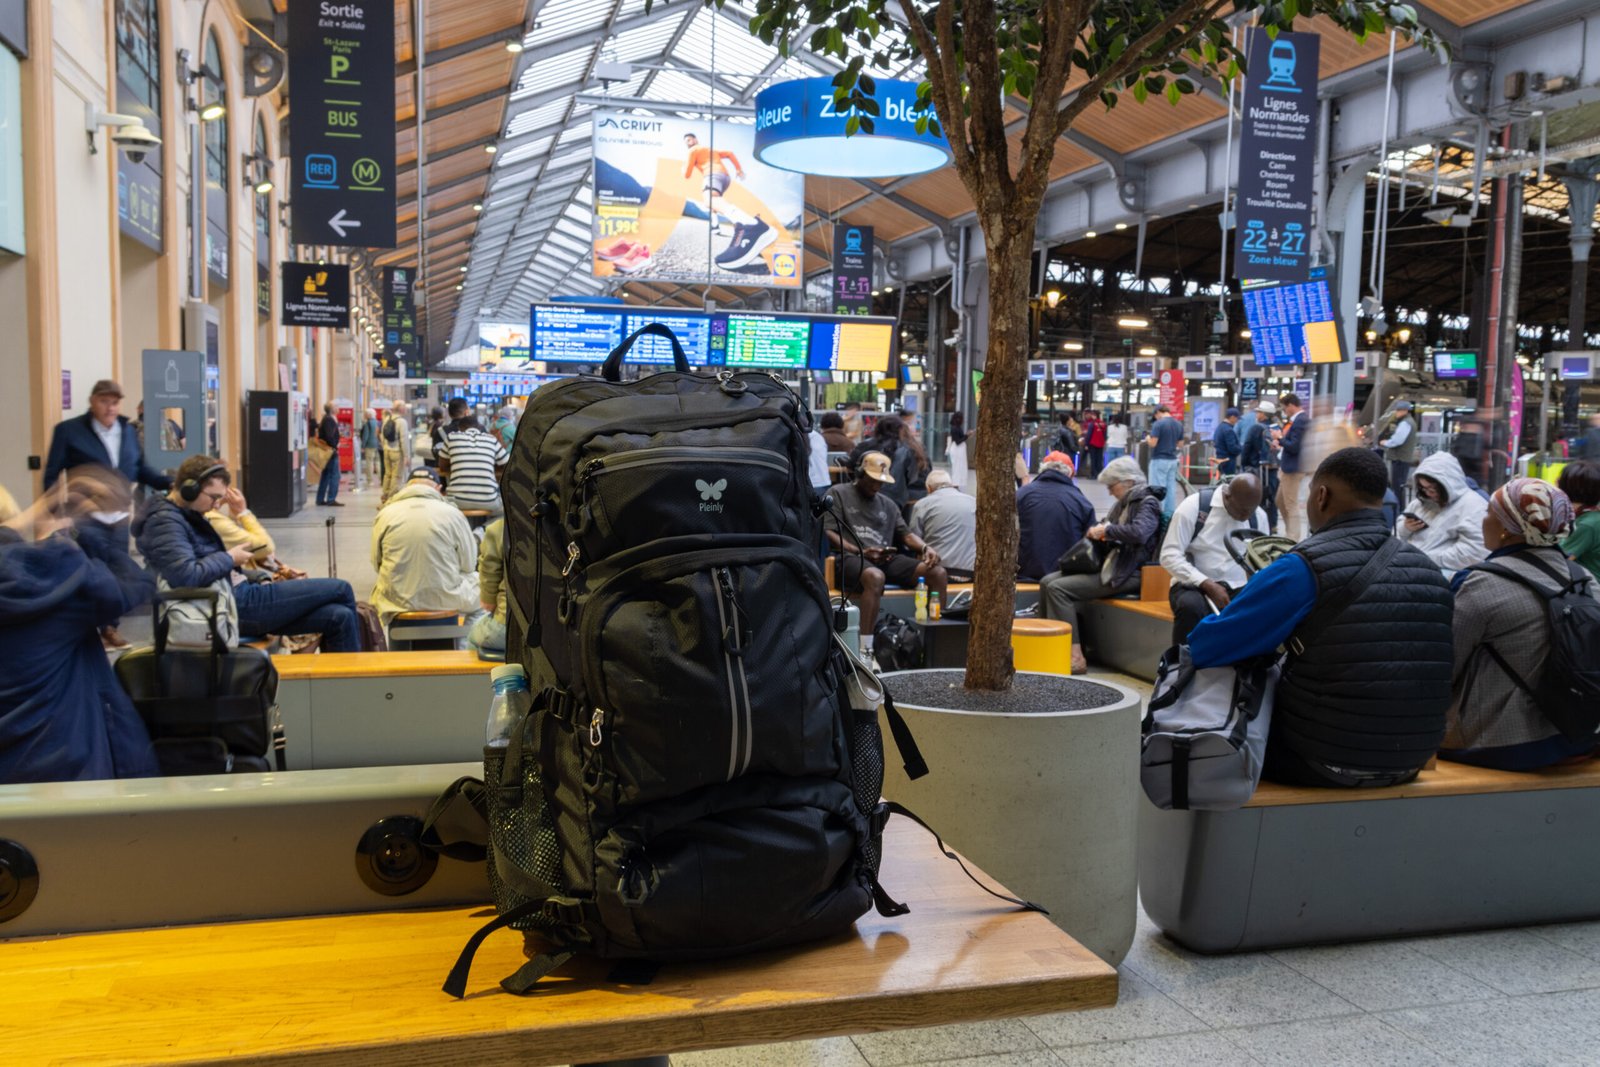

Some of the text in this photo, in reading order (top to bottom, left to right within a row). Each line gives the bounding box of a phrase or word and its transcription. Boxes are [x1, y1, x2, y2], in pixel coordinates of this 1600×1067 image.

[320, 2, 364, 18] Sortie
[318, 18, 366, 30] Exit Salida
[323, 37, 360, 47] St-Lazare
[333, 46, 352, 54] Paris
[331, 55, 350, 78] P
[1264, 96, 1298, 111] Lignes
[328, 111, 358, 127] BUS
[756, 105, 792, 130] bleue
[1250, 107, 1310, 124] Normandes
[620, 120, 663, 132] CRIVIT
[1260, 150, 1296, 161] Directions
[310, 163, 374, 180] RER M
[1268, 161, 1286, 170] Caen
[1260, 170, 1295, 182] Cherbourg
[1266, 180, 1288, 189] Rouen
[1271, 191, 1291, 199] Havre
[1246, 198, 1308, 210] Trouville Deauville
[1242, 228, 1306, 252] 22 à 27
[1248, 254, 1298, 266] Zone bleue
[840, 281, 846, 290] 1
[857, 282, 869, 292] 11
[286, 302, 346, 313] Lignes Normandes
[830, 324, 841, 370] Information
[1244, 381, 1257, 392] 22
[699, 502, 723, 514] Pleinly
